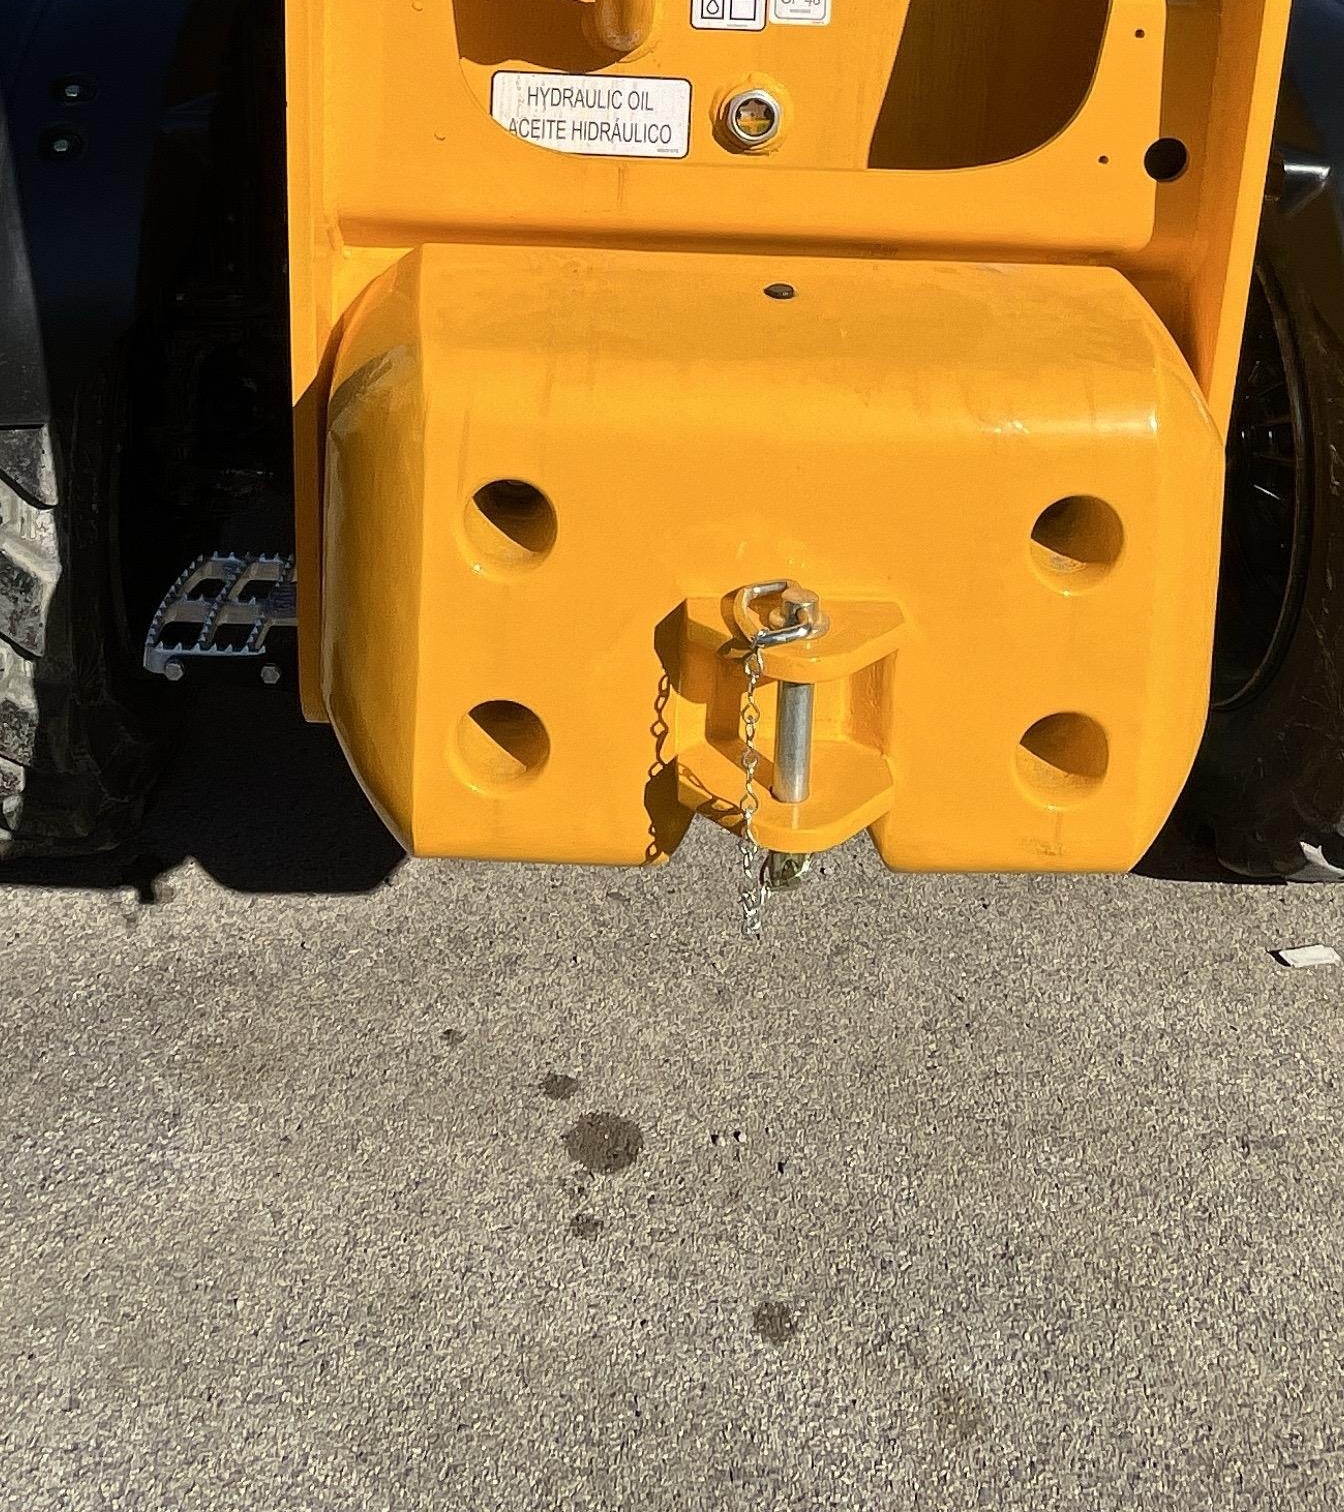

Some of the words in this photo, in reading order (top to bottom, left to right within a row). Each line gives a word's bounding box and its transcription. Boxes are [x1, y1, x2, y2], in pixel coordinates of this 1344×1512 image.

[527, 87, 623, 111] HYDRAULIC
[627, 90, 654, 112] OIL
[508, 117, 567, 140] ACEITE
[571, 117, 673, 145] HIDRÁULICO
